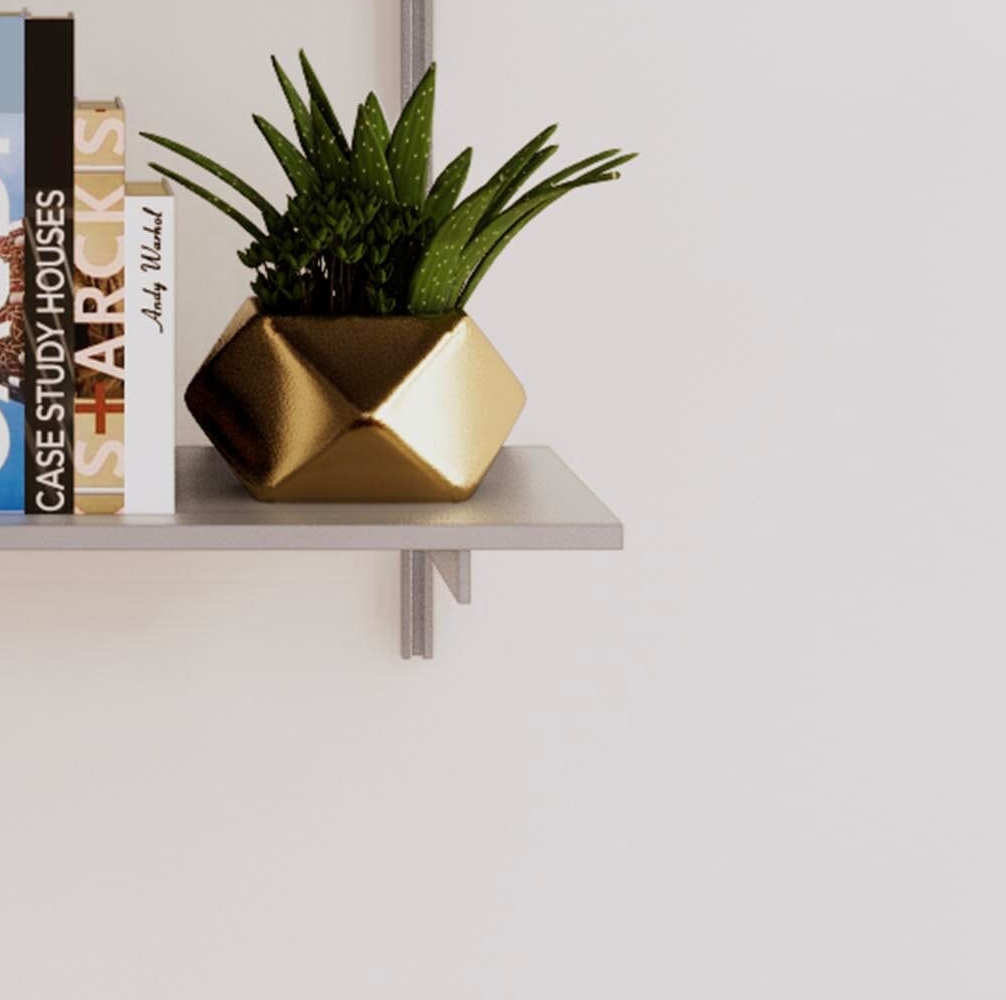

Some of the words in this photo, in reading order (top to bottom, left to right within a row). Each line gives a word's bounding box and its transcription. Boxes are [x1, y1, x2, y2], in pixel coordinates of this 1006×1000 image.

[35, 189, 66, 315] HOUSES
[140, 206, 163, 273] Warhol
[140, 281, 168, 334] Andy
[35, 322, 66, 421] STUDY
[35, 440, 66, 513] CASE
